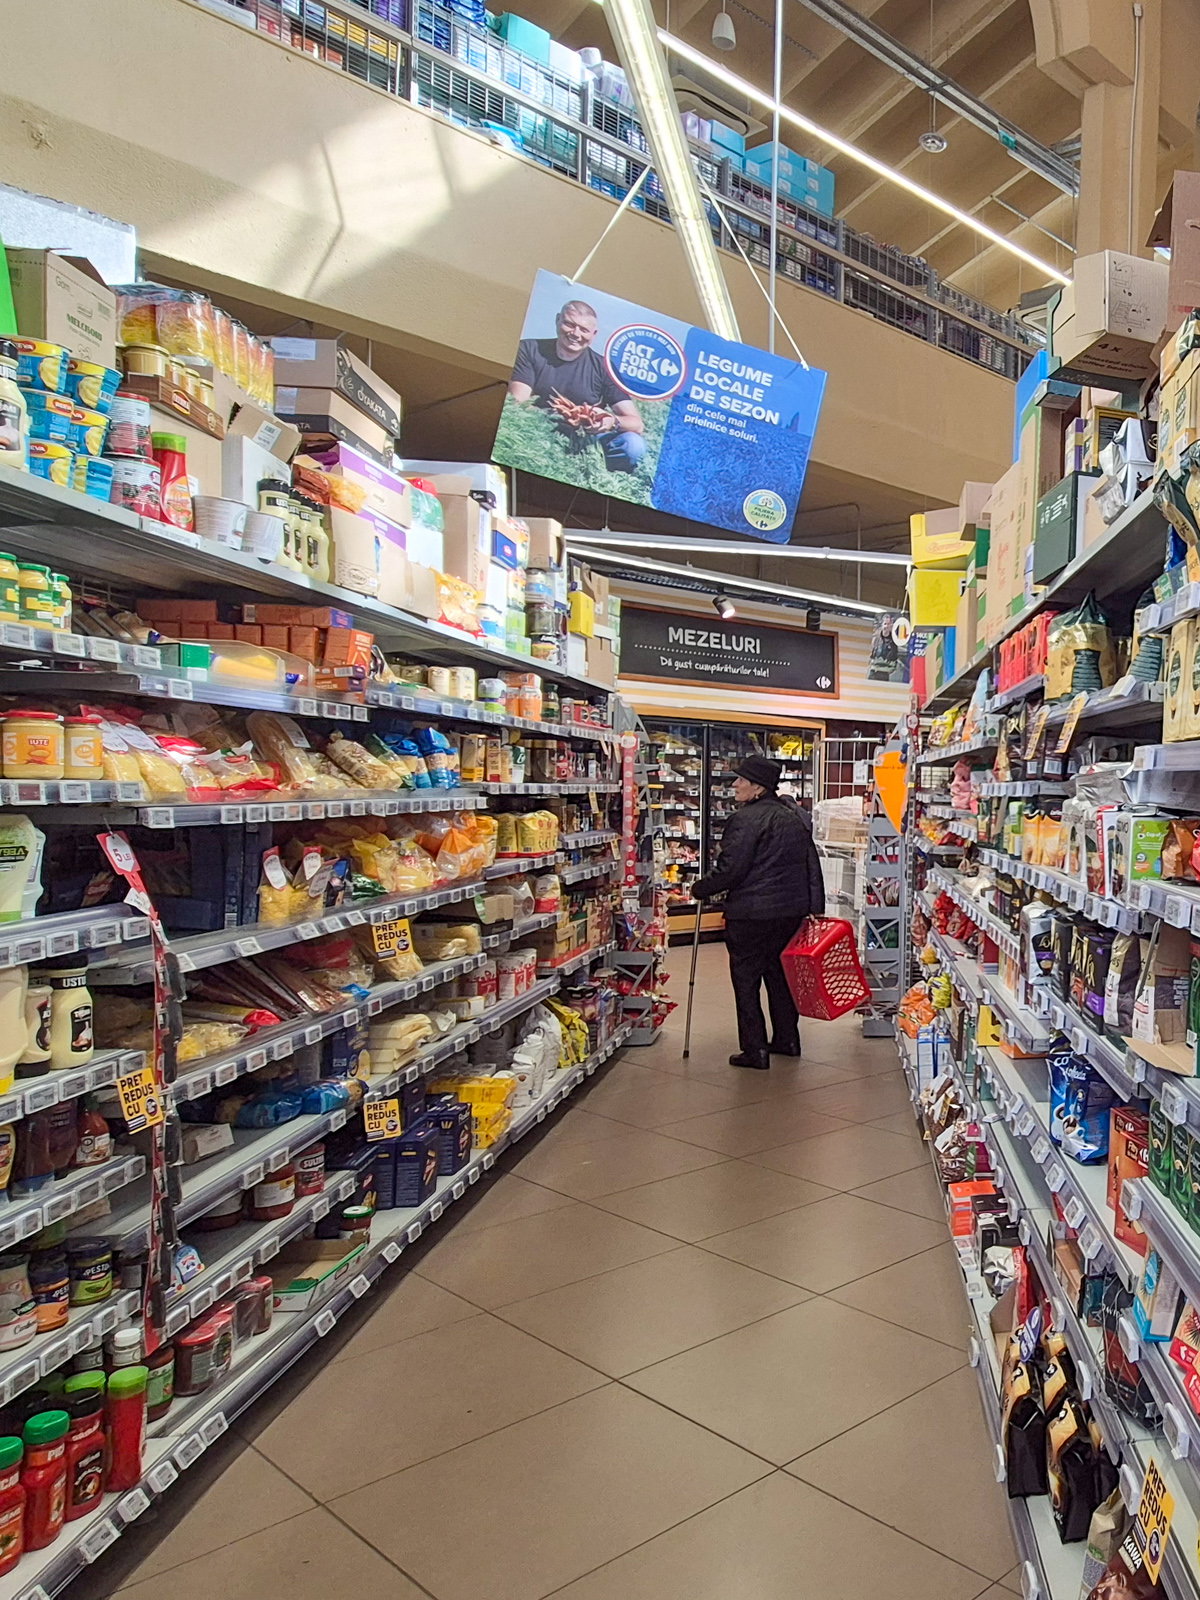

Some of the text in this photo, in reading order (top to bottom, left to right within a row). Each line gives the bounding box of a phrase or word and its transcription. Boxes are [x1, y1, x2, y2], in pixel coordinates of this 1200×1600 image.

[624, 340, 656, 358] ACT
[621, 353, 650, 371] FOR
[697, 351, 774, 387] LEGUME
[619, 365, 659, 384] FOOD
[693, 370, 764, 402] LOCALE
[690, 386, 780, 425] DE SEZON
[687, 402, 747, 429] din cele mai
[683, 414, 759, 444] prielnice soluri.
[667, 626, 761, 655] MEZELURI
[674, 658, 693, 671] gust
[752, 667, 770, 678] tale!
[113, 847, 123, 864] 5
[375, 922, 399, 933] PRET
[376, 928, 408, 941] REDUS
[377, 940, 392, 951] CU
[119, 1073, 144, 1091] PRET
[123, 1083, 155, 1105] REDUS
[126, 1103, 141, 1117] CU
[365, 1102, 389, 1112] PRET
[366, 1109, 398, 1121] REDUS
[367, 1120, 381, 1130] CU
[1148, 1459, 1167, 1496] PRET
[1139, 1498, 1151, 1528] CU
[1143, 1479, 1168, 1536] REDUS
[1123, 1535, 1143, 1569] KAWA
